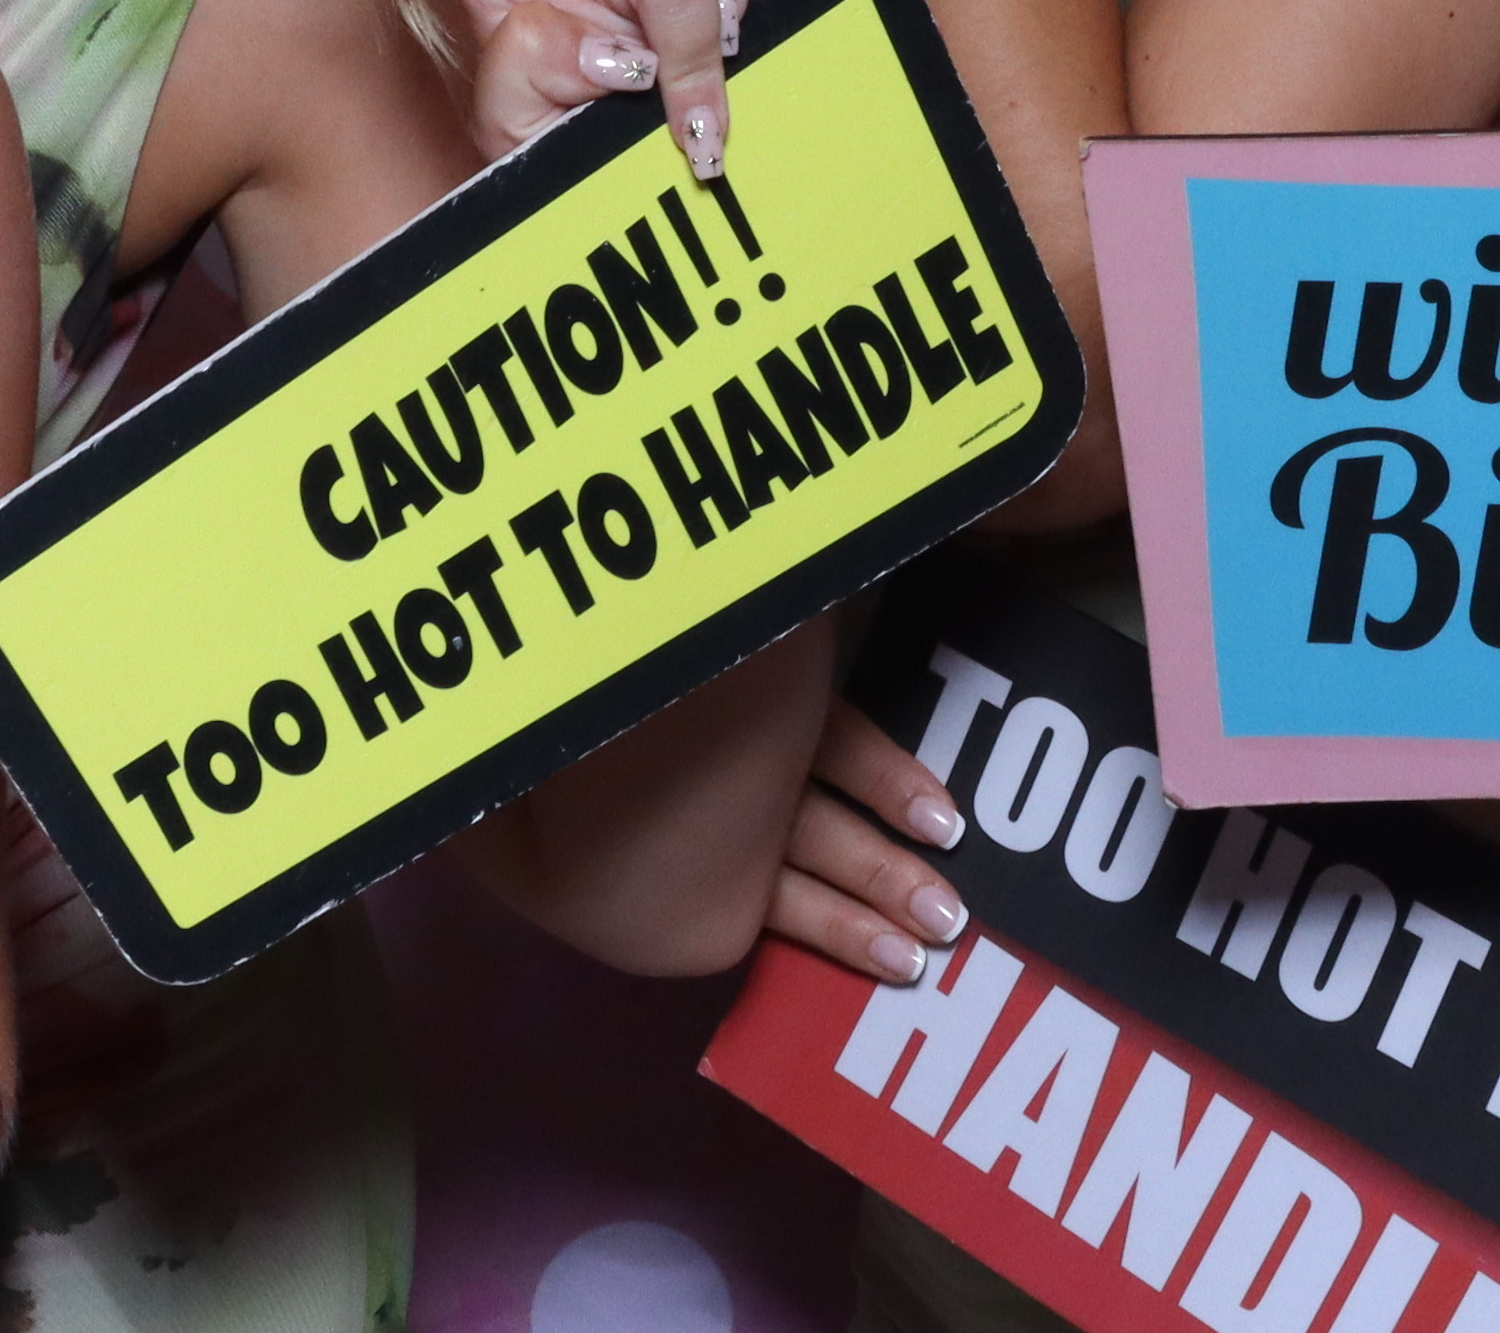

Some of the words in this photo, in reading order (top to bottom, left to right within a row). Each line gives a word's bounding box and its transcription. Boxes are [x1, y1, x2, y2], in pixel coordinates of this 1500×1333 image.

[113, 679, 329, 853] TOO
[318, 534, 523, 743] HOT
[508, 472, 659, 618] TO
[641, 235, 1015, 549] HANDLE
[300, 171, 787, 563] CAUTION!!
[913, 641, 1179, 905] TOO
[1174, 807, 1494, 1070] HOT
